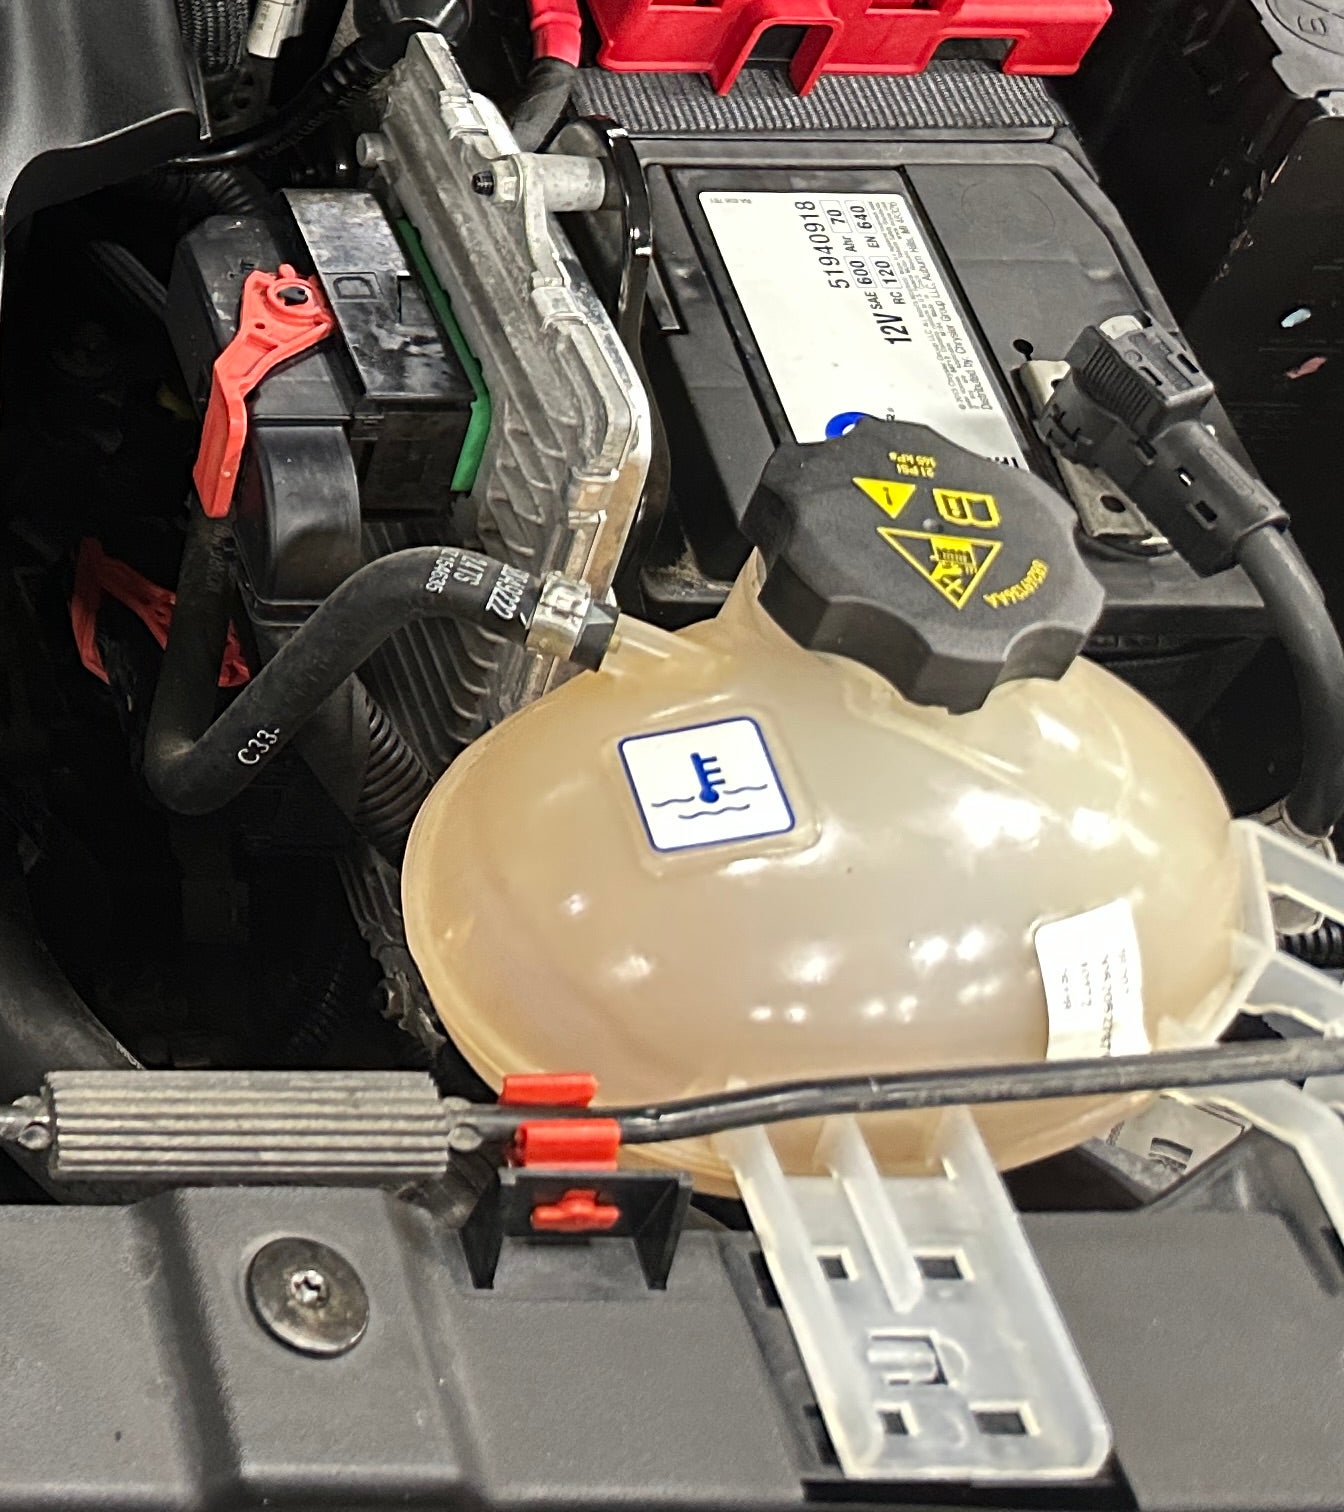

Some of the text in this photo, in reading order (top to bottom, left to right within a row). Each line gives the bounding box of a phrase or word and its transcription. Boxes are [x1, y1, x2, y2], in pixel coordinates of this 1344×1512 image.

[847, 205, 874, 229] 640
[791, 199, 852, 289] 51940918
[863, 235, 881, 248] EN
[824, 208, 884, 310] SAE 600 Ahr 70
[872, 259, 899, 284] 120
[888, 291, 906, 304] RC
[871, 312, 915, 346] 12V
[896, 463, 919, 476] PSI
